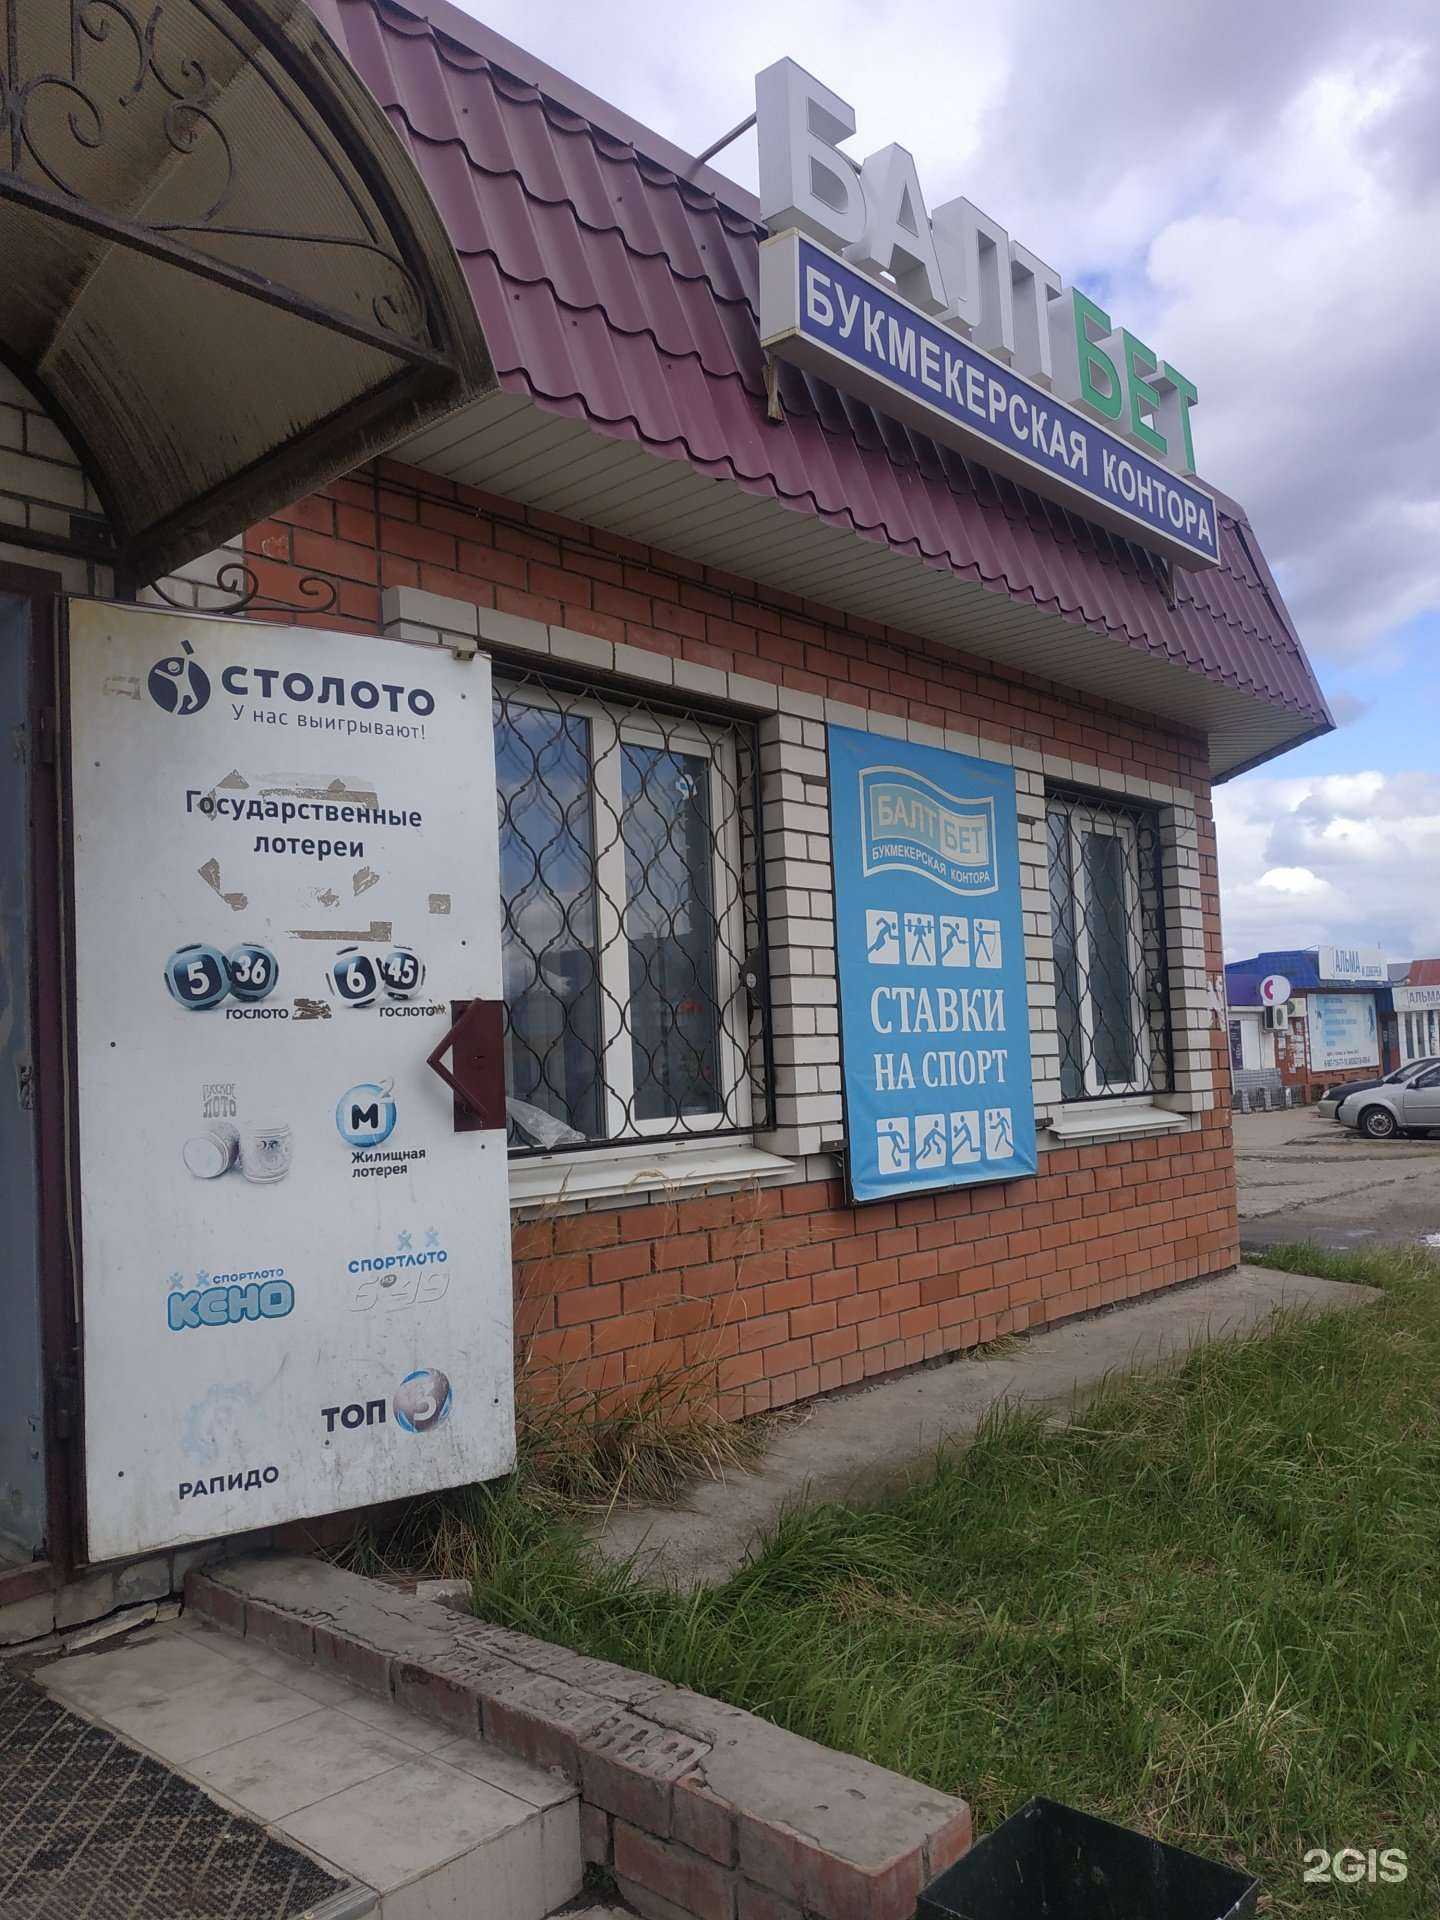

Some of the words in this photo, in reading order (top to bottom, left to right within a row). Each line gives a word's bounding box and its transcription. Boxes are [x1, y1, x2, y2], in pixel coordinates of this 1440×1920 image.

[806, 264, 1089, 477] БУКМЕКЕРСКАЯ
[1102, 448, 1213, 547] КОНТОРА
[221, 665, 435, 717] СТОЛОТО
[232, 704, 245, 721] У
[253, 709, 289, 727] нас
[297, 713, 427, 741] выигрывают!
[186, 790, 423, 828] Государственные
[254, 835, 365, 861] лотереи
[872, 844, 946, 876] БУКМЕКЕРСКАЯ
[950, 866, 990, 884] КОНТОРА
[187, 962, 210, 996] 5
[235, 953, 266, 986] 36
[346, 962, 367, 993] 6
[388, 957, 415, 984] 45
[226, 1008, 289, 1020] ГОСЛОТО
[380, 1006, 435, 1017] ГОСЛОТО
[870, 986, 1007, 1034] СТАВКИ
[873, 1052, 916, 1091] НА
[922, 1049, 1008, 1088] СПОРТ
[351, 1147, 427, 1165] Жилищная
[352, 1163, 408, 1178] лотерея
[213, 1268, 284, 1284] СПОРТЛОТО
[348, 1250, 447, 1274] СПОРТЛОТО
[167, 1280, 295, 1331] КЕНО
[321, 1398, 387, 1433] ТОП
[178, 1466, 280, 1500] РАПИДО
